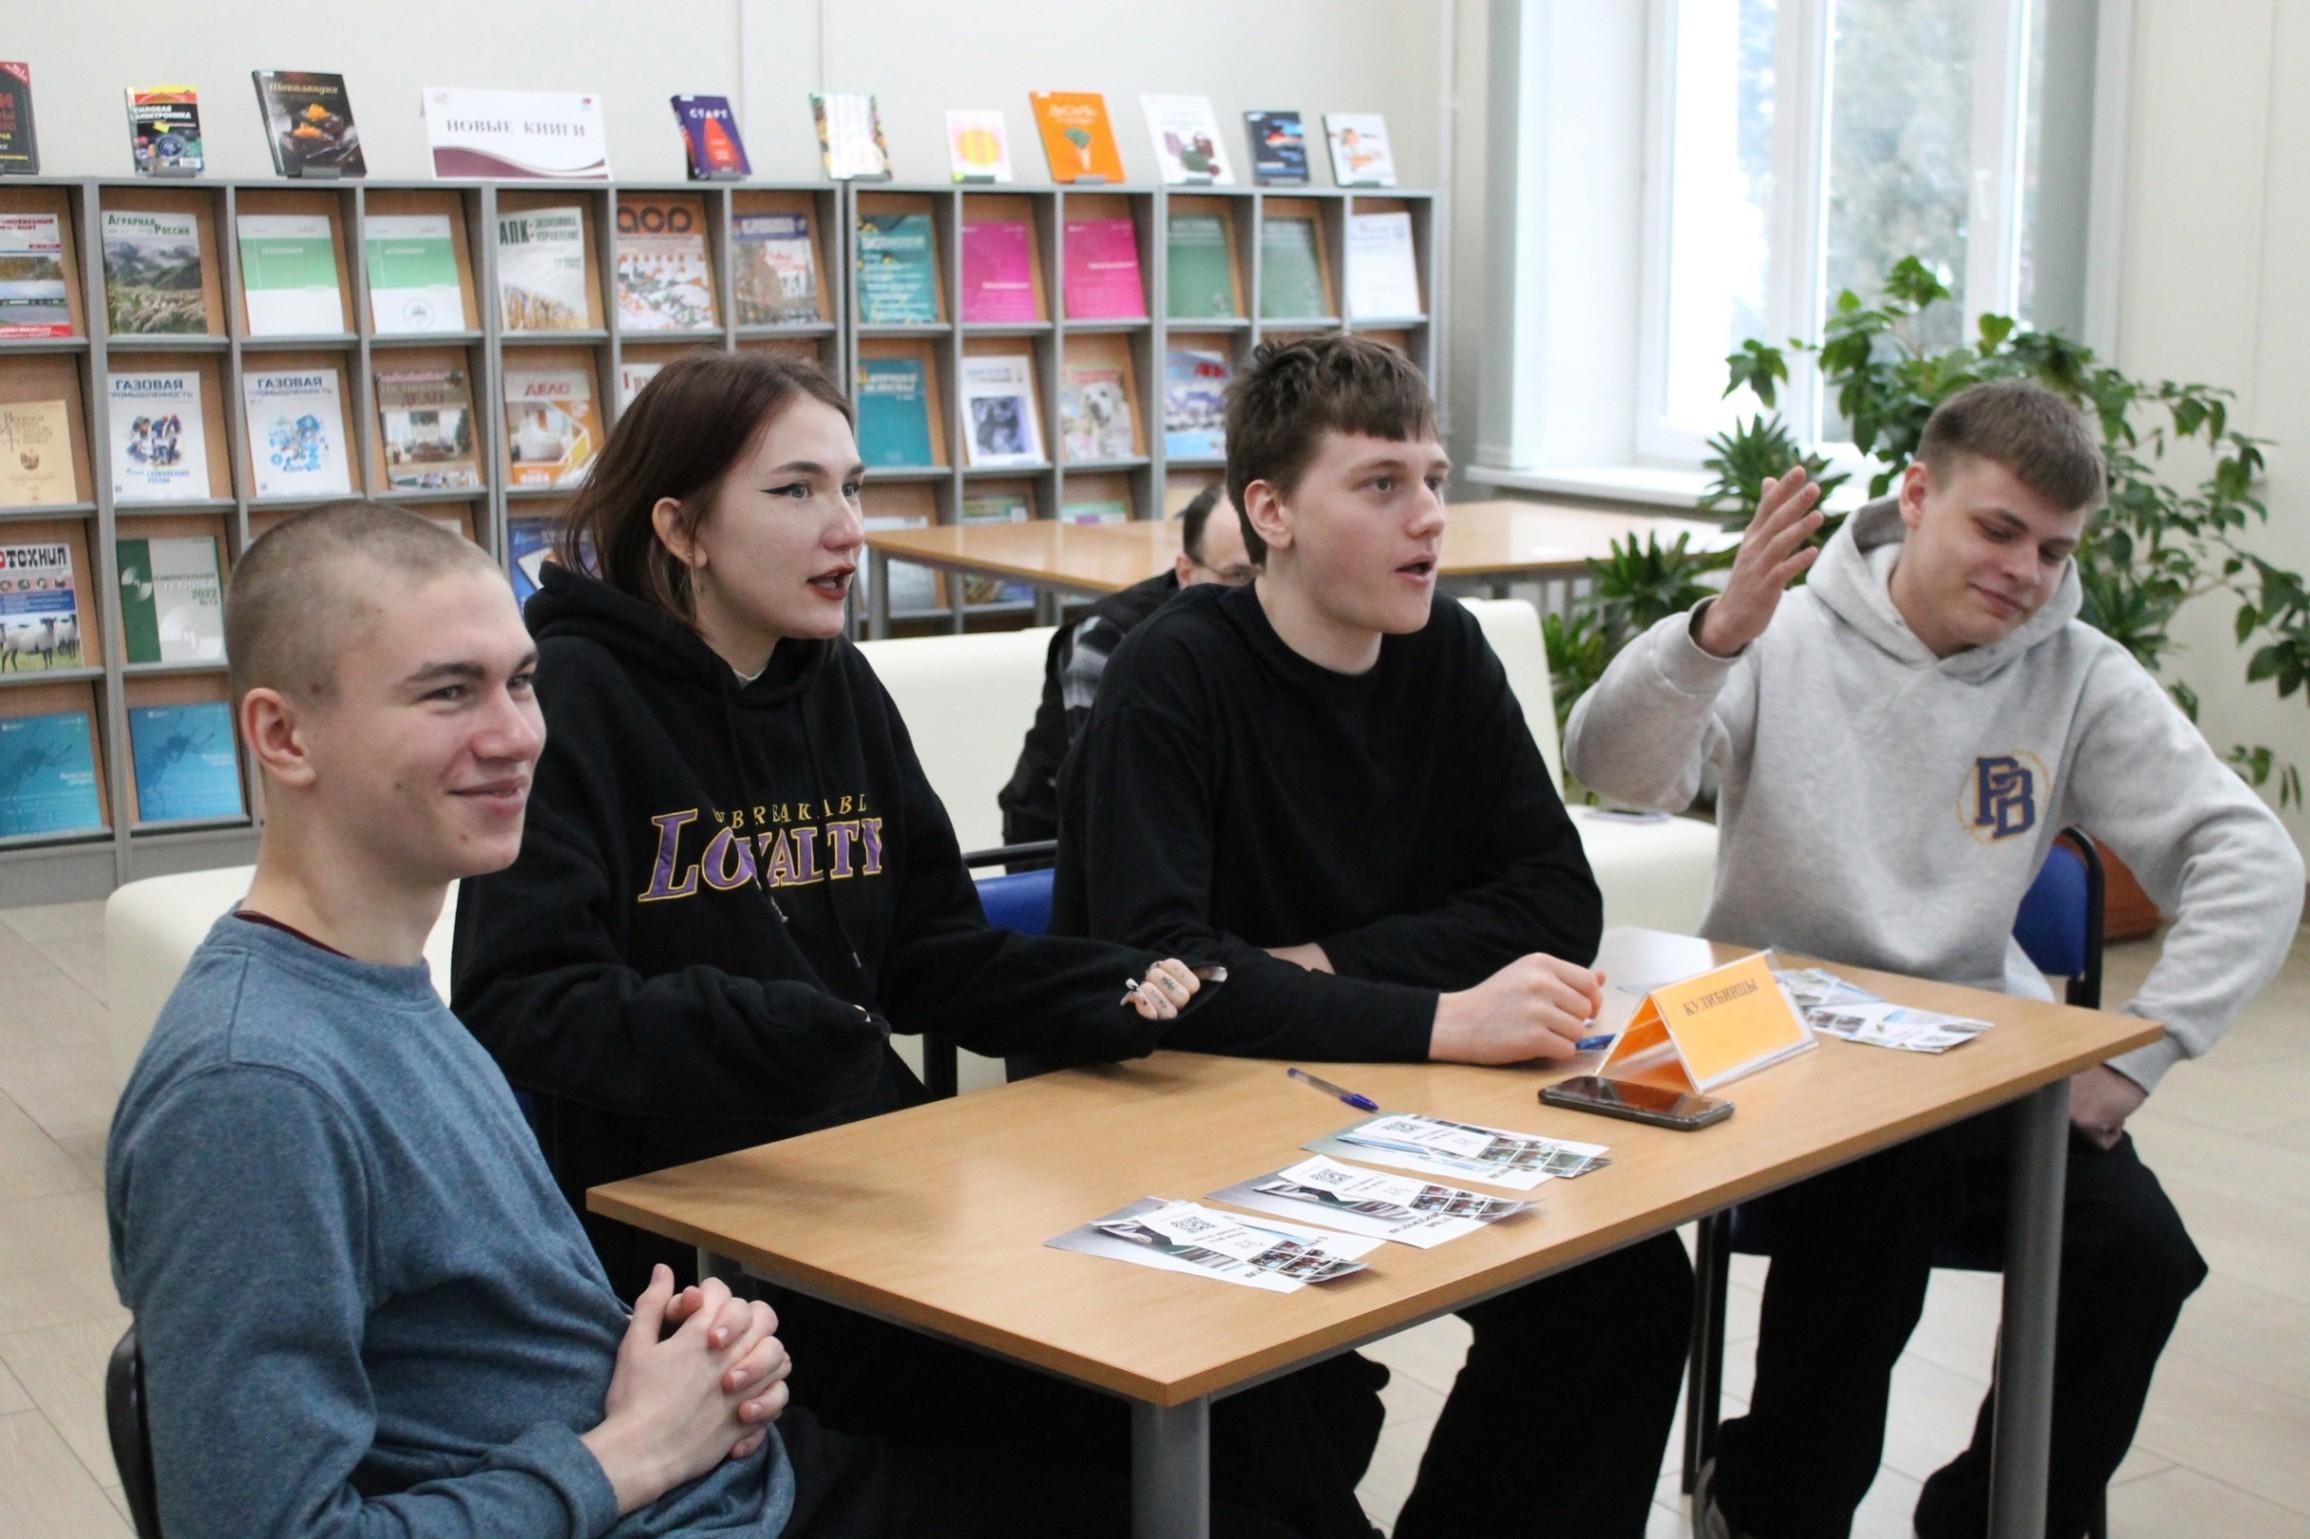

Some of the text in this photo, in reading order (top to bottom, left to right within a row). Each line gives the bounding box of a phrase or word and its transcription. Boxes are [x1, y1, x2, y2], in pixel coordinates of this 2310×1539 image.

[447, 119, 586, 137] НОВЫЕ КНИГИ
[115, 379, 184, 391] ГАЗОВАЯ
[257, 376, 323, 389] ГАЗОВАЯ
[637, 808, 883, 903] LOYALTY
[1682, 978, 1760, 1017] КУЛИБИНЦЫ
